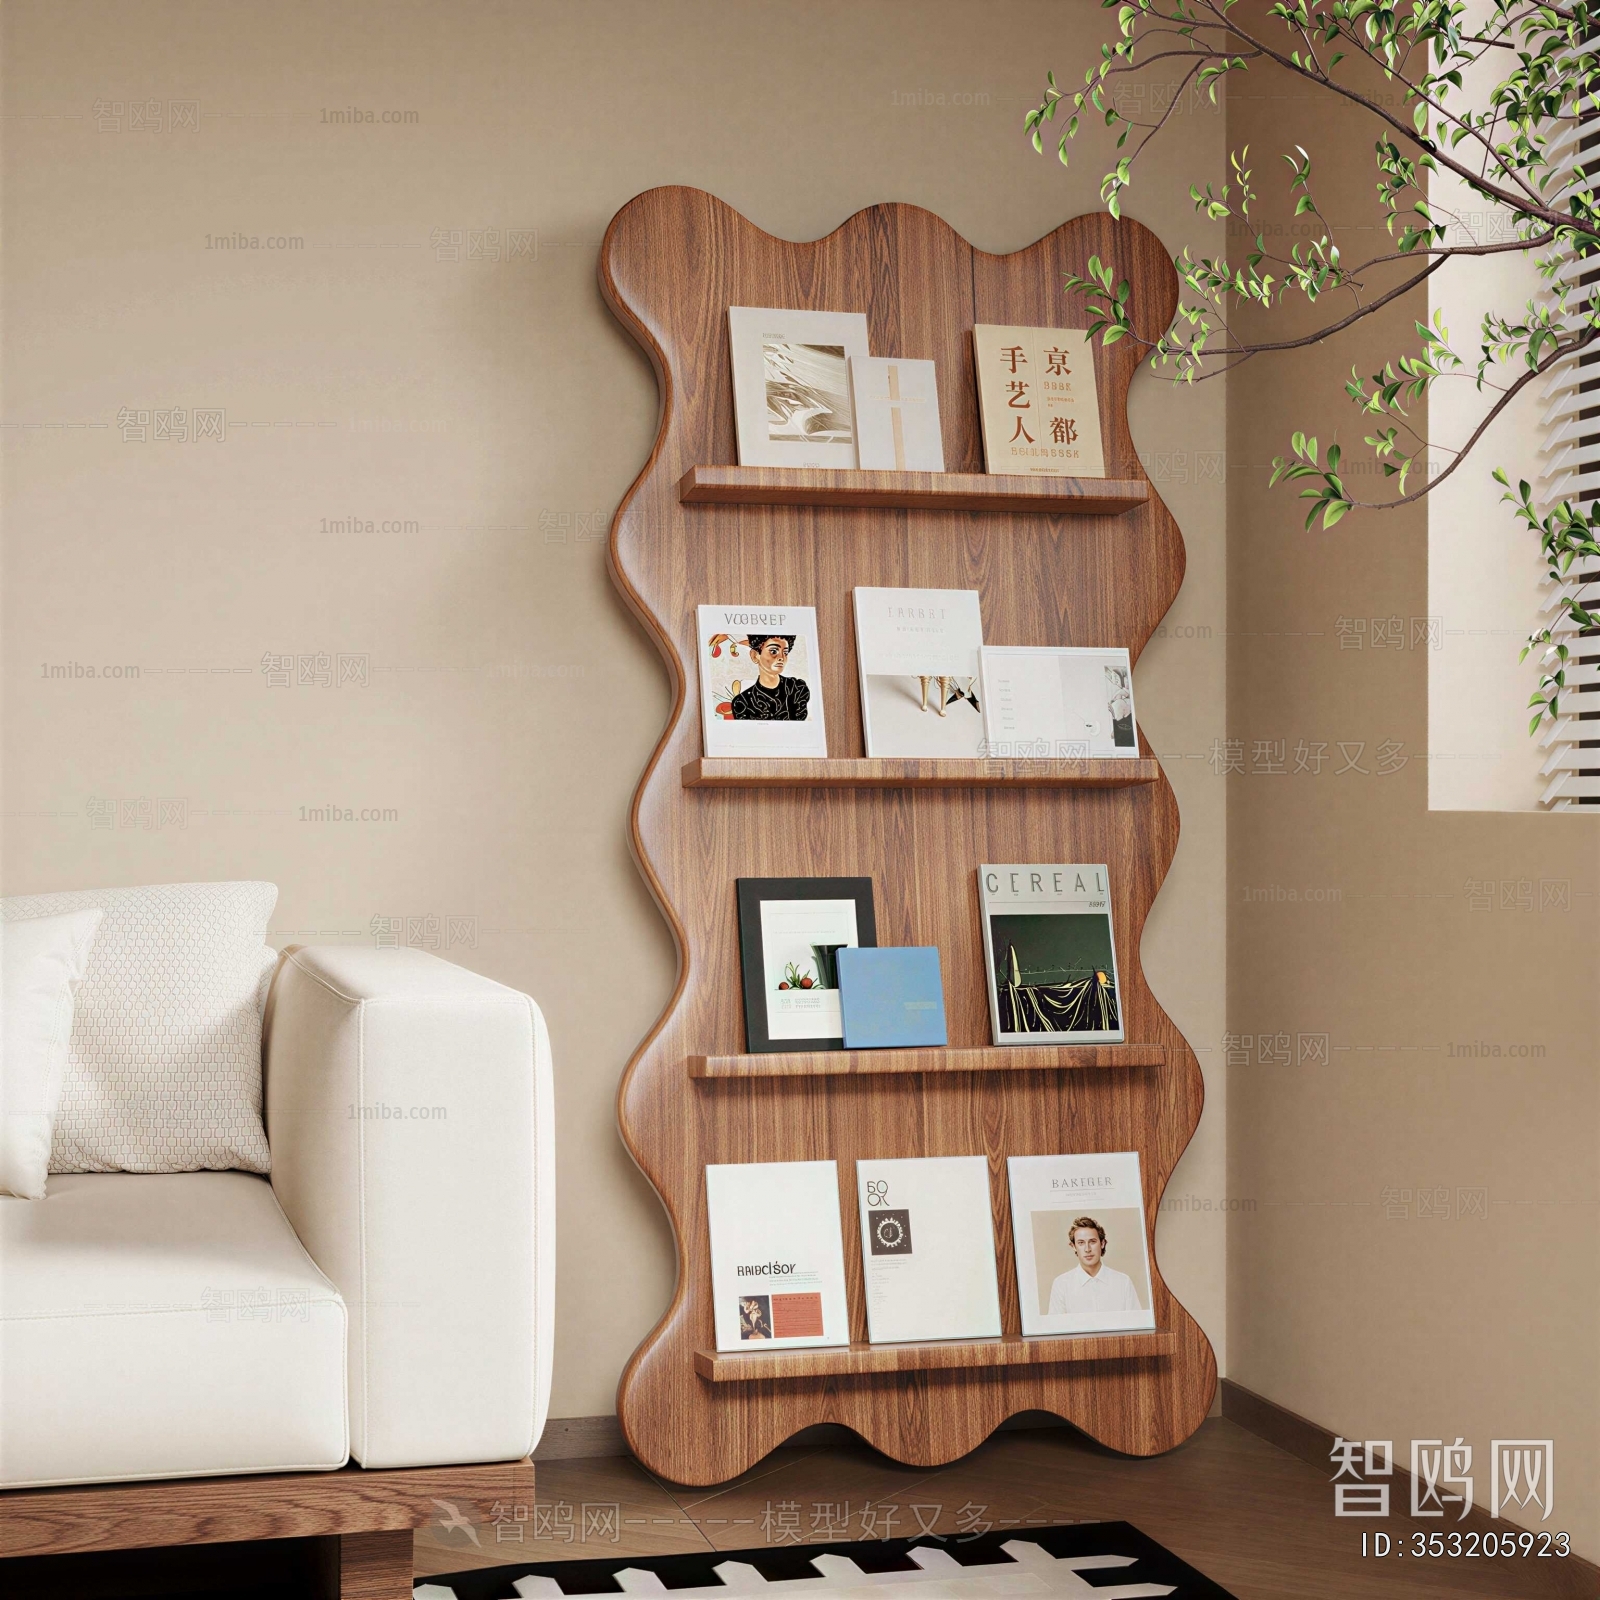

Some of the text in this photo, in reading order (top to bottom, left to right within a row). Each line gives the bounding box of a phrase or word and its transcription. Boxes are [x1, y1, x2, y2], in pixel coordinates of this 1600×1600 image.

[1000, 345, 1035, 444] 手艺人
[986, 872, 1105, 893] CEREAL
